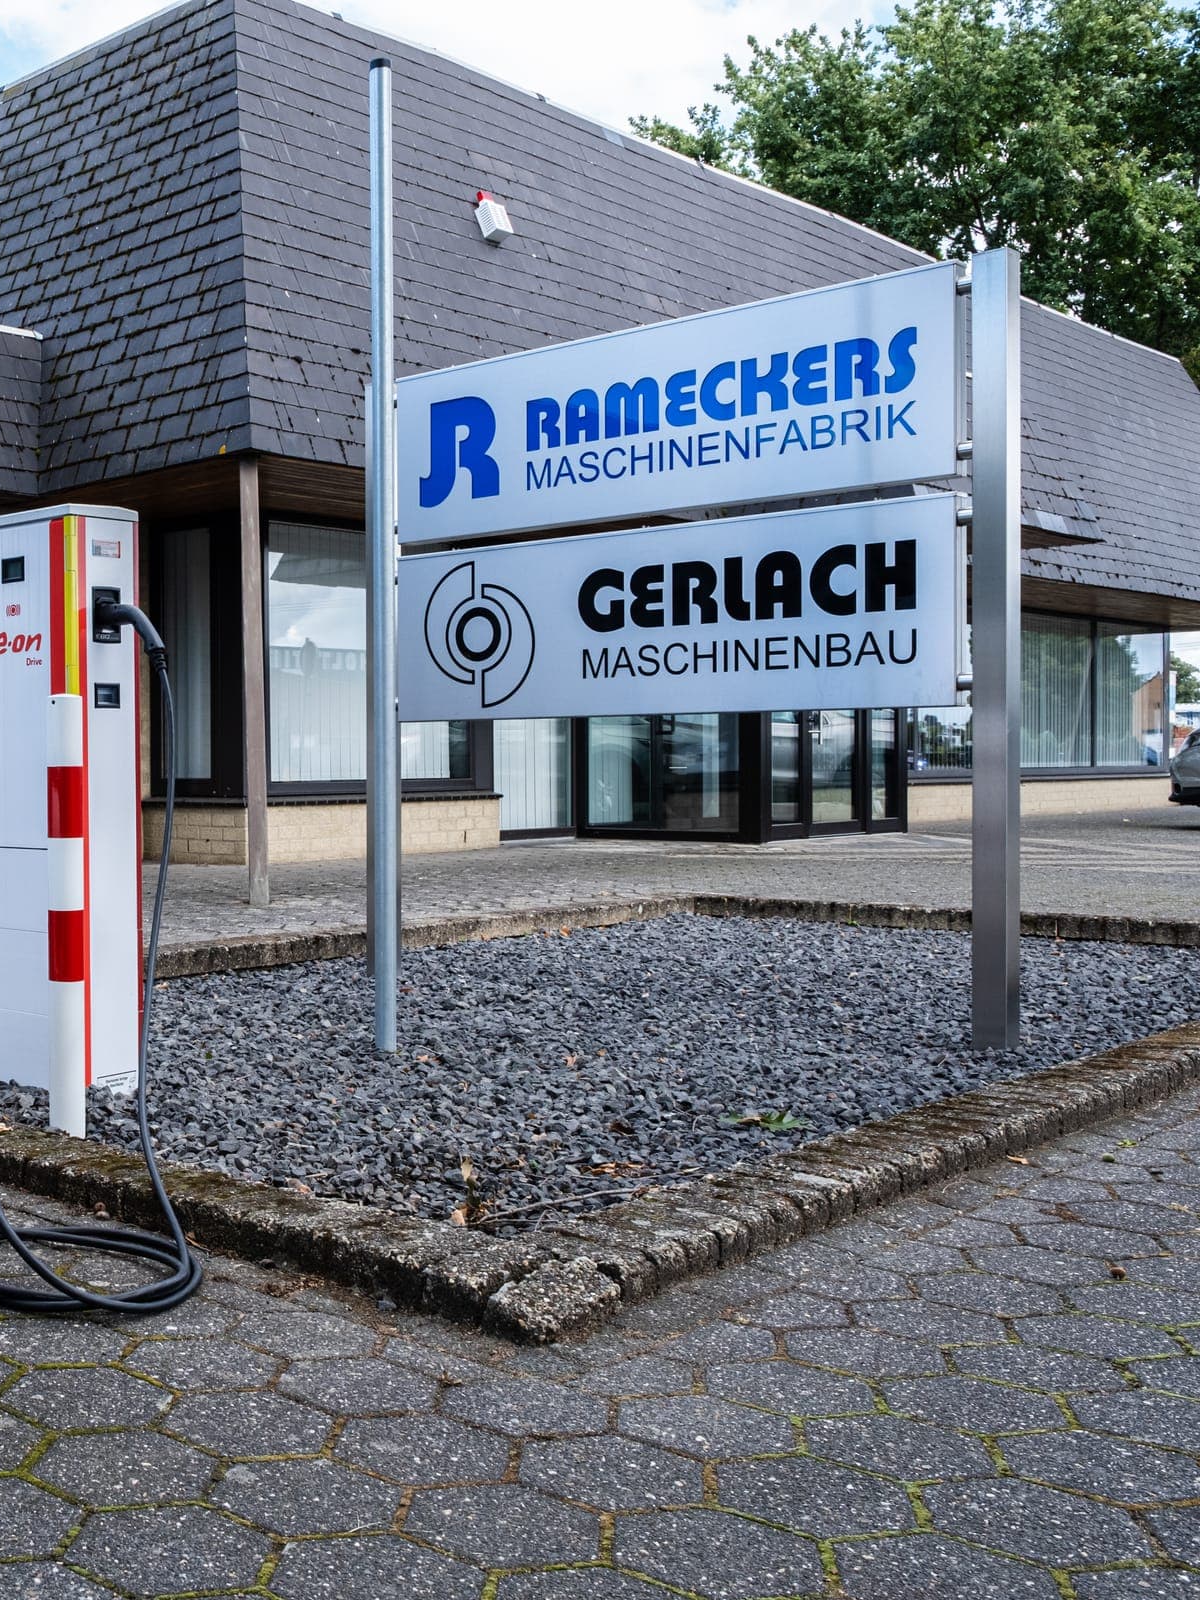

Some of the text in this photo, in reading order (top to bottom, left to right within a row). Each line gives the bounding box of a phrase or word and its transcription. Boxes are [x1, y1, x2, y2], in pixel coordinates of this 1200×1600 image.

[525, 326, 918, 453] RAMECKERS
[526, 400, 918, 492] MASCHINENFABRIK
[577, 538, 917, 633] GERLACH
[26, 657, 43, 667] Drive
[582, 628, 918, 680] MASCHINENBAU
